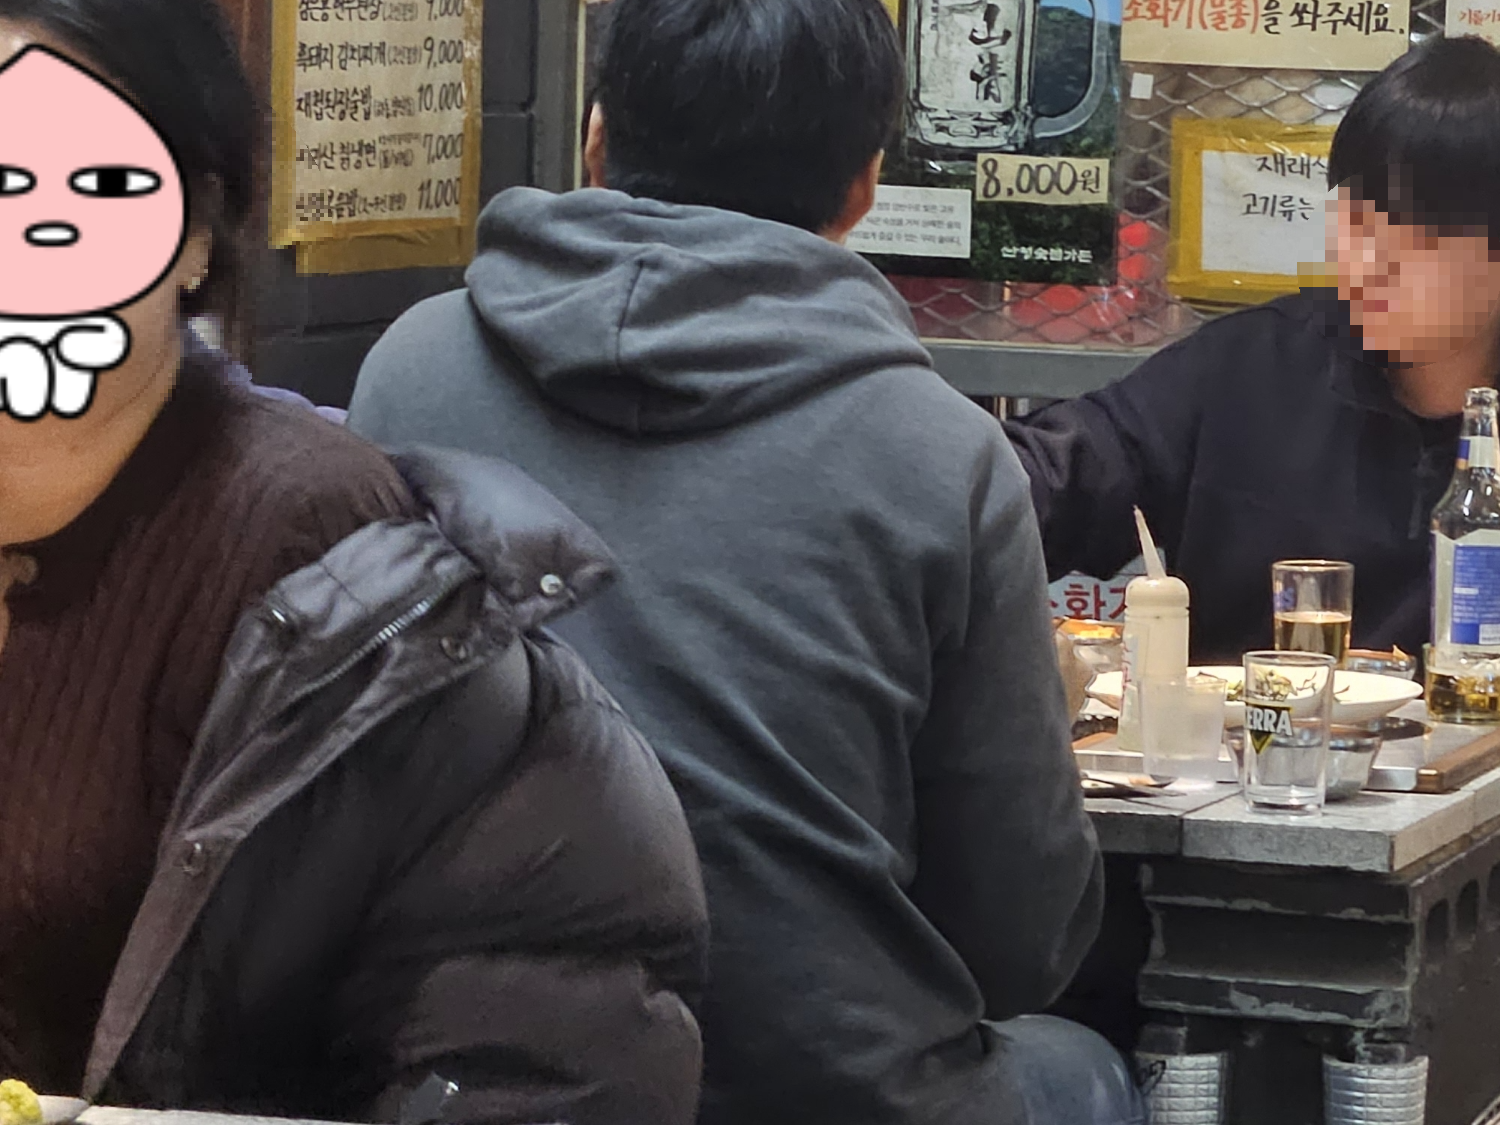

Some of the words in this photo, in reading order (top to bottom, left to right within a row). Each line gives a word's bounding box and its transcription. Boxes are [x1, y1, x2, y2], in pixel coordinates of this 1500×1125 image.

[296, 41, 334, 71] 흑돼지
[1240, 191, 1316, 222] 고기류는
[1244, 705, 1293, 737] ERRA
